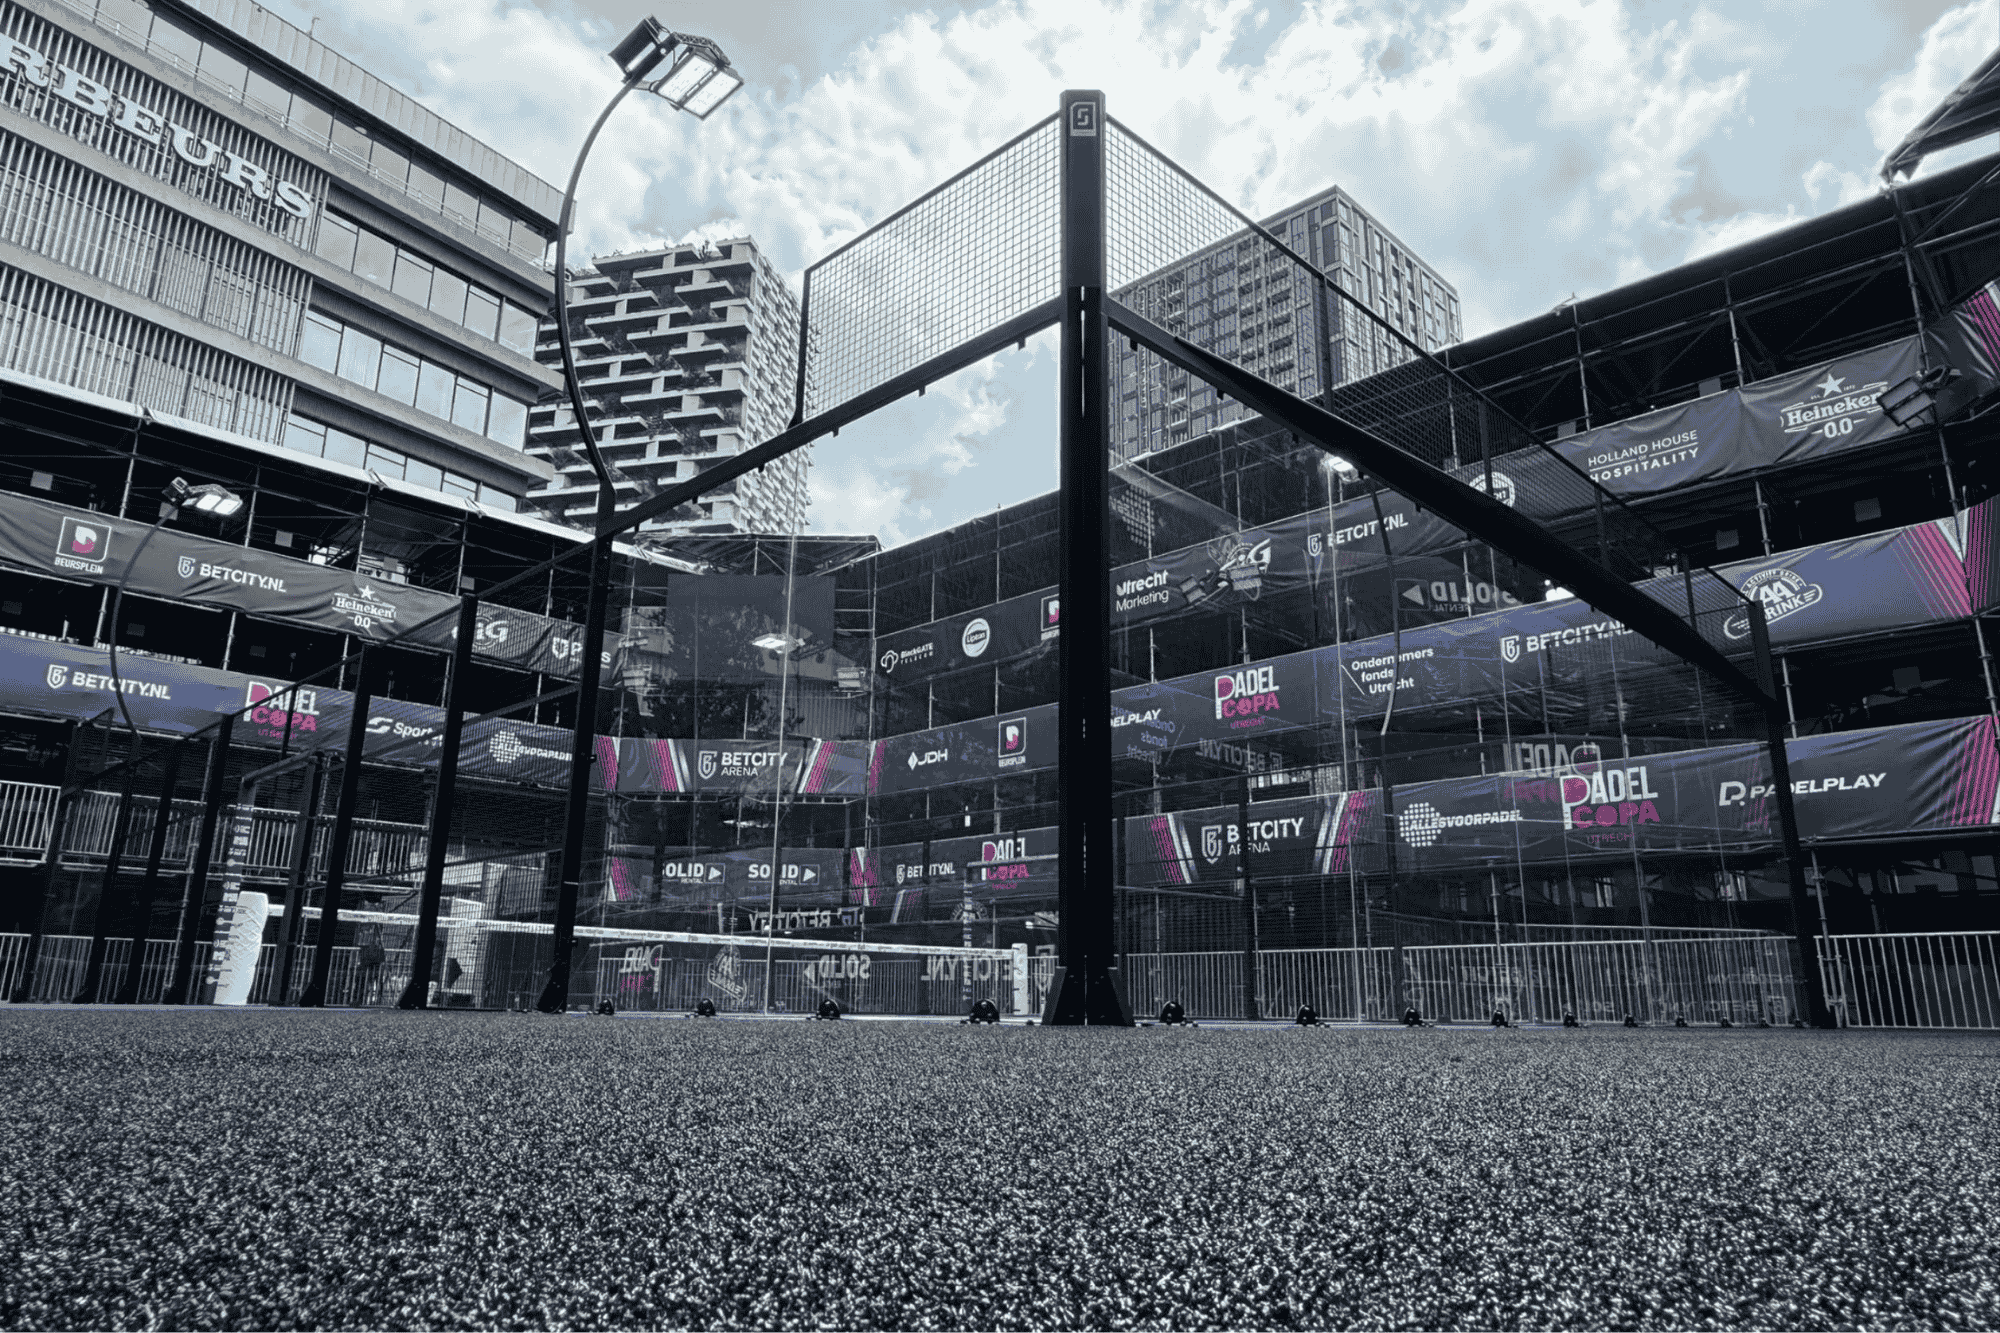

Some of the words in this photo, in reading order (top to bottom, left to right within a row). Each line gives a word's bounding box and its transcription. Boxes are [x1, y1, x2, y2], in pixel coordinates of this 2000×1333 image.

[0, 32, 313, 219] RBEURS
[1588, 444, 1648, 467] HOLLAND
[1652, 429, 1698, 450] HOUSE
[1589, 447, 1699, 483] HOSPITALITY
[1327, 513, 1409, 548] BETCIT.NL
[54, 557, 104, 575] BEURSPLEIN
[199, 563, 287, 593] BETCITY.NL
[1116, 569, 1169, 597] Utrecht
[1760, 580, 1795, 604] AA
[335, 597, 394, 618] Heineken
[1116, 589, 1169, 612] Marketing
[1763, 593, 1806, 620] RINK
[1351, 648, 1434, 671] Ondernmers
[1361, 668, 1395, 683] fonds
[1215, 665, 1280, 720] PADEL
[1221, 692, 1280, 718] COPA
[721, 752, 788, 767] BETCITY
[721, 766, 759, 776] ARENA
[1560, 766, 1659, 830] PADEL
[1410, 809, 1523, 830] ALLESVOORPADEL
[1572, 800, 1660, 829] COPA
[1227, 817, 1304, 843] BTCITY
[662, 863, 704, 877] OLID
[748, 864, 799, 879] SOID
[907, 862, 956, 878] BETITY.NL
